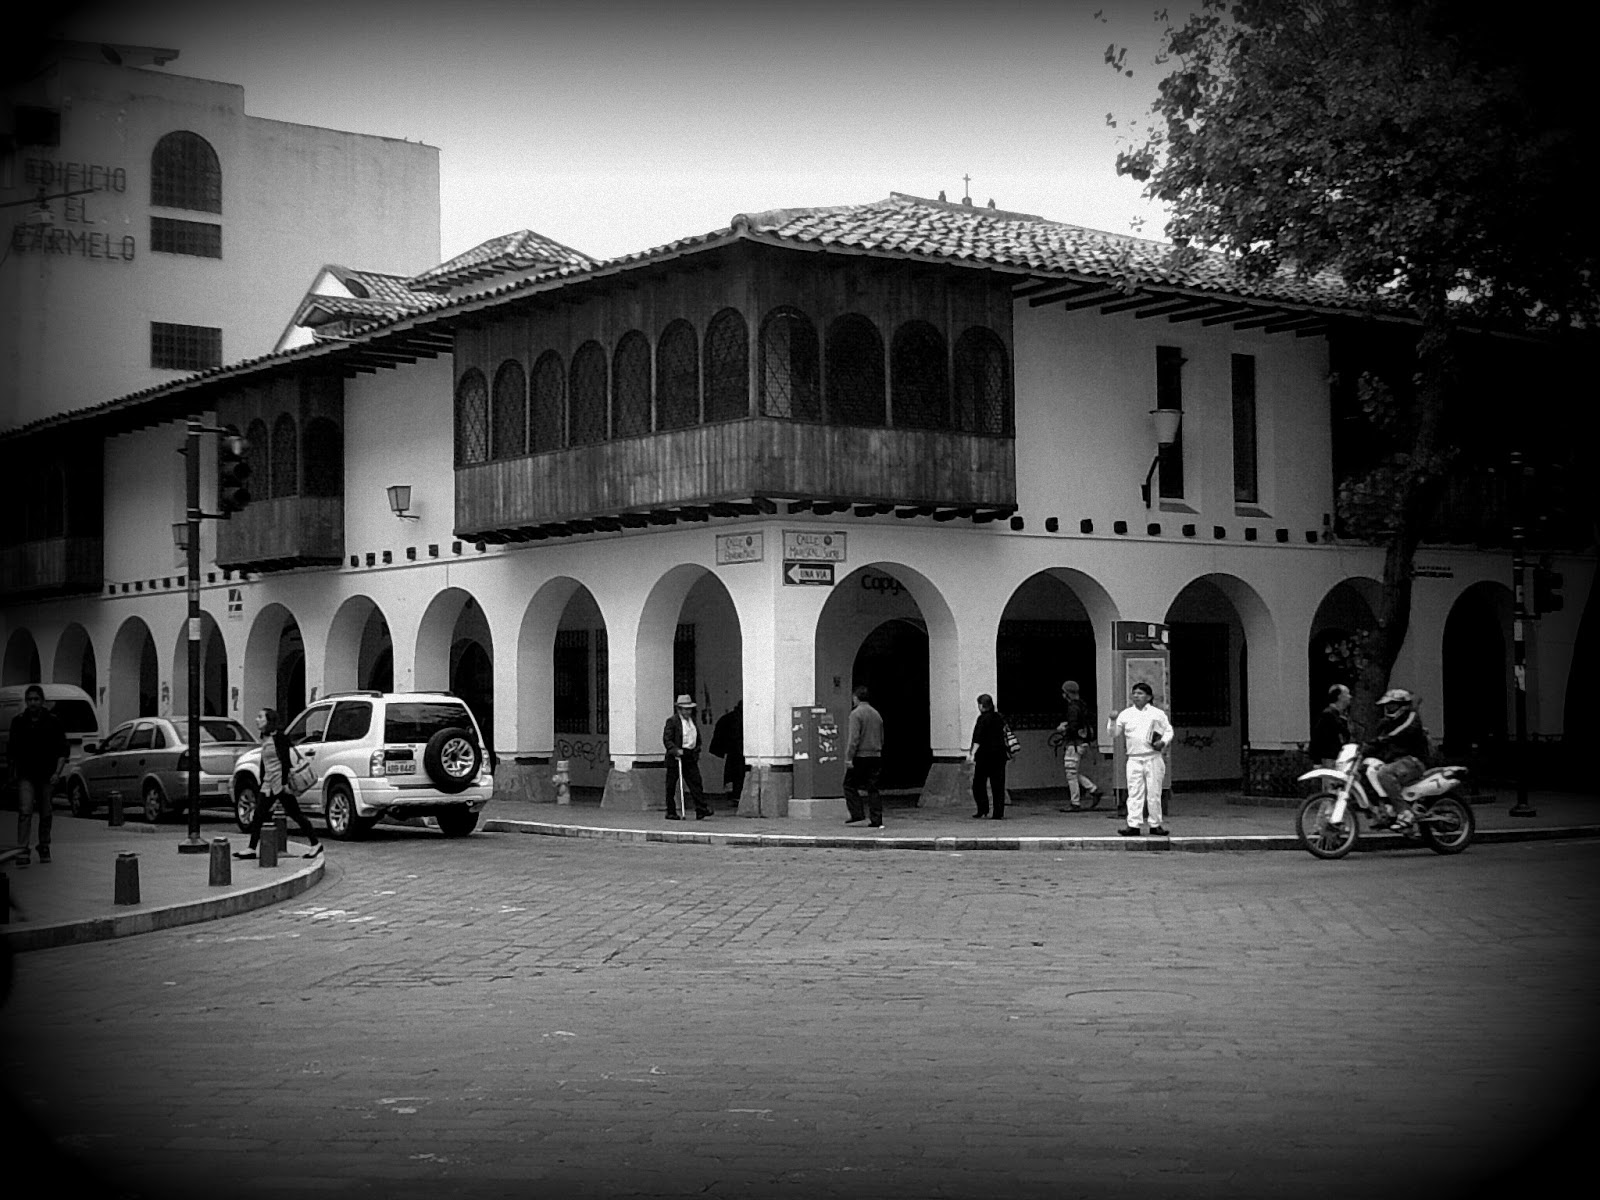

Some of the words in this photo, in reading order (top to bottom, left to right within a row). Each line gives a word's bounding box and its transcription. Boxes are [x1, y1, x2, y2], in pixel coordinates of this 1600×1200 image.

[24, 158, 126, 193] EDIFICIO
[64, 196, 95, 224] EL
[12, 223, 135, 261] CARMELO
[801, 570, 814, 579] UNA
